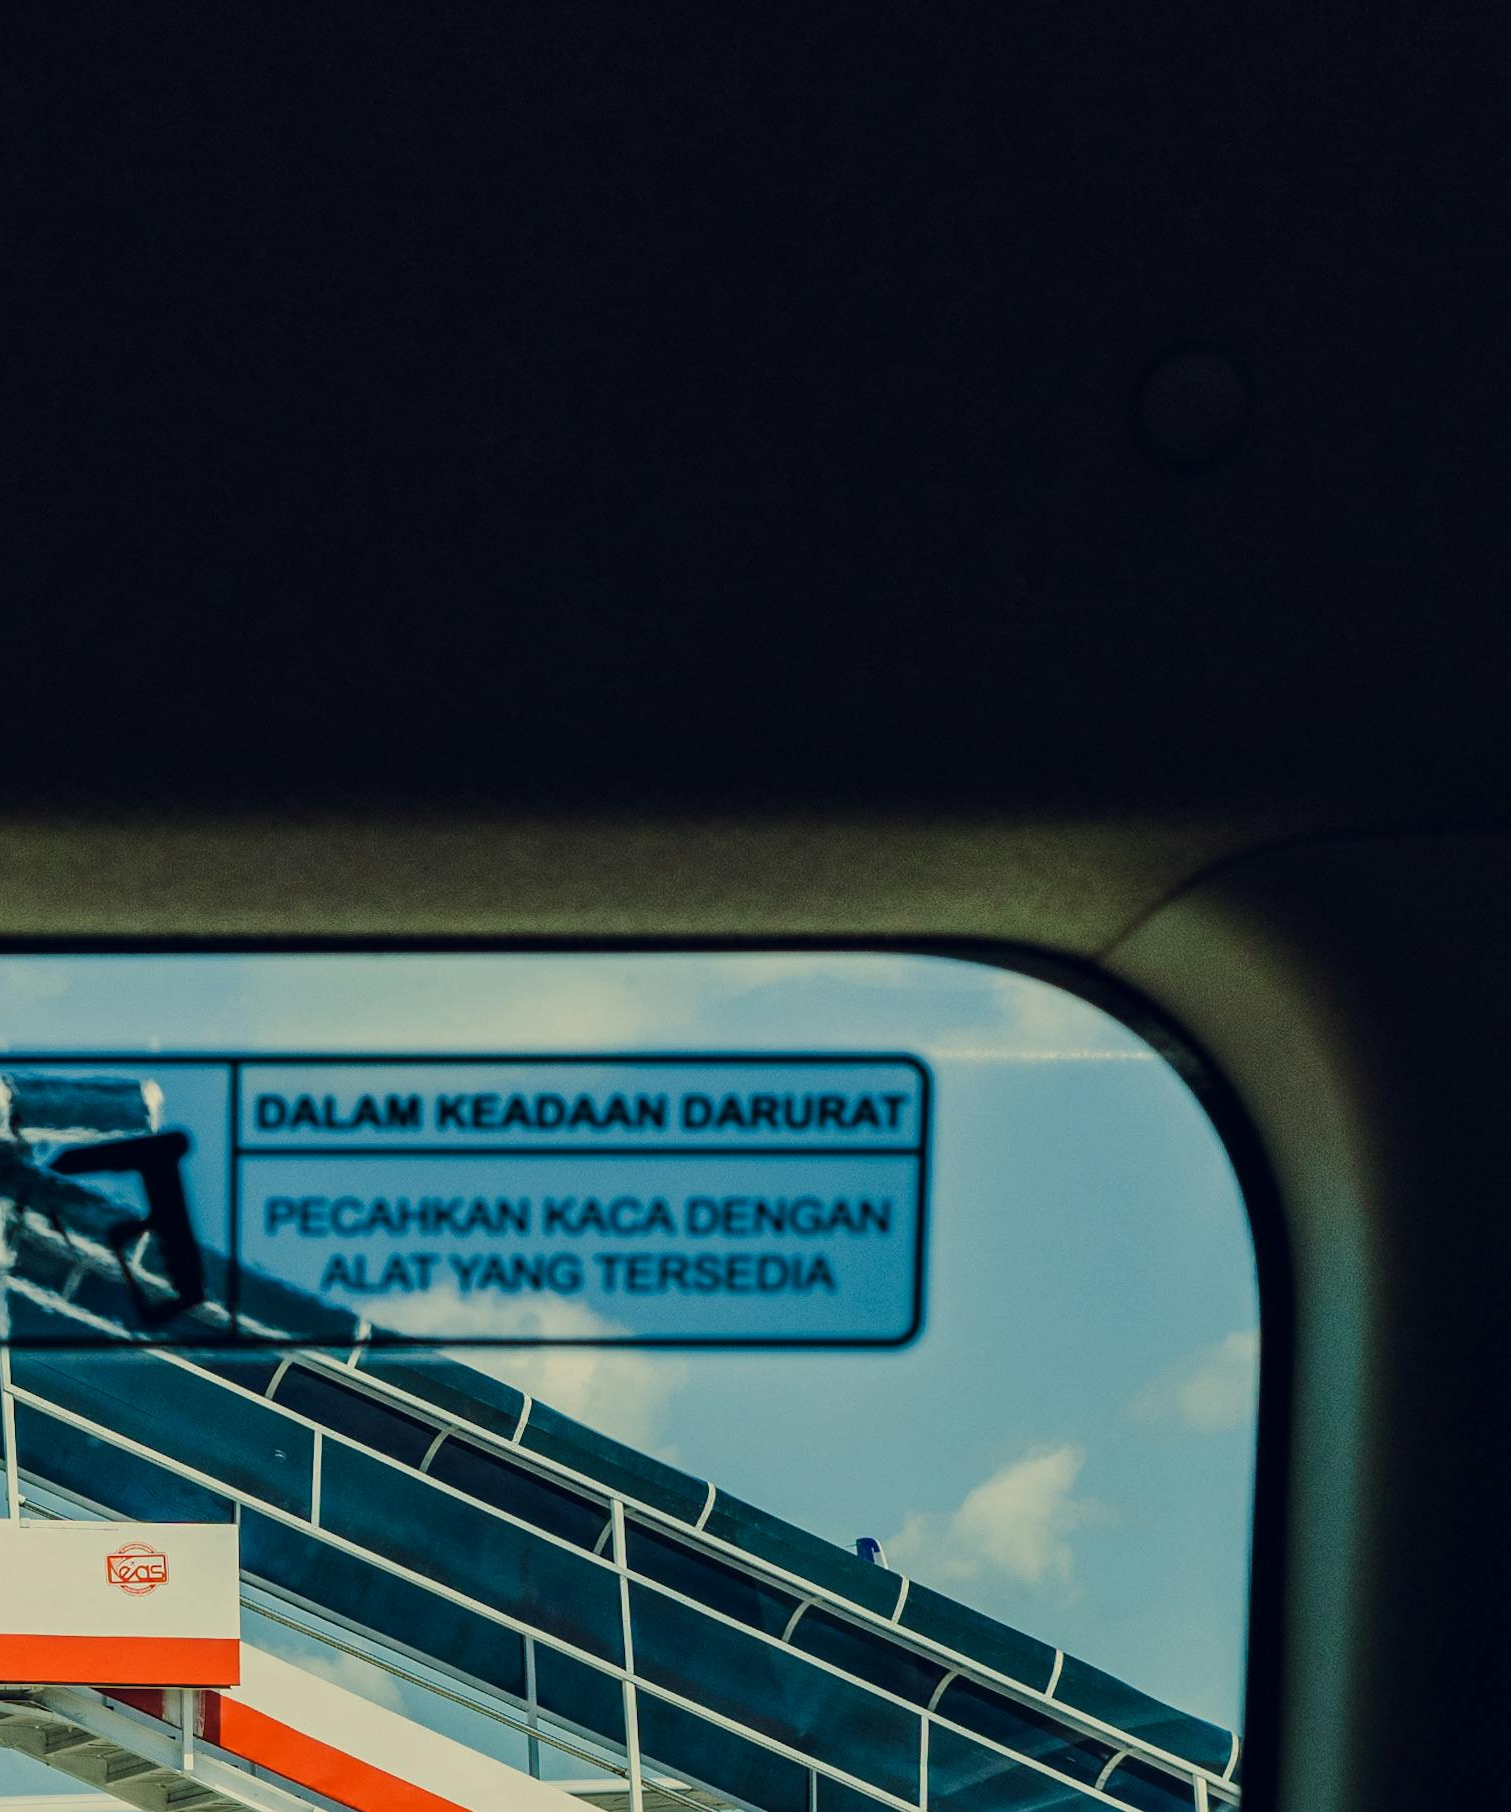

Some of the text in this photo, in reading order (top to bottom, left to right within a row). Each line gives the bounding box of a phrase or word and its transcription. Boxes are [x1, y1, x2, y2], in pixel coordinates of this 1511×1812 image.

[256, 1094, 907, 1132] DALAM KEADAAN DARURAT
[267, 1197, 889, 1235] PECAHKAN KACA DENGAN
[323, 1254, 835, 1293] ALAT YANG TERSEDIA
